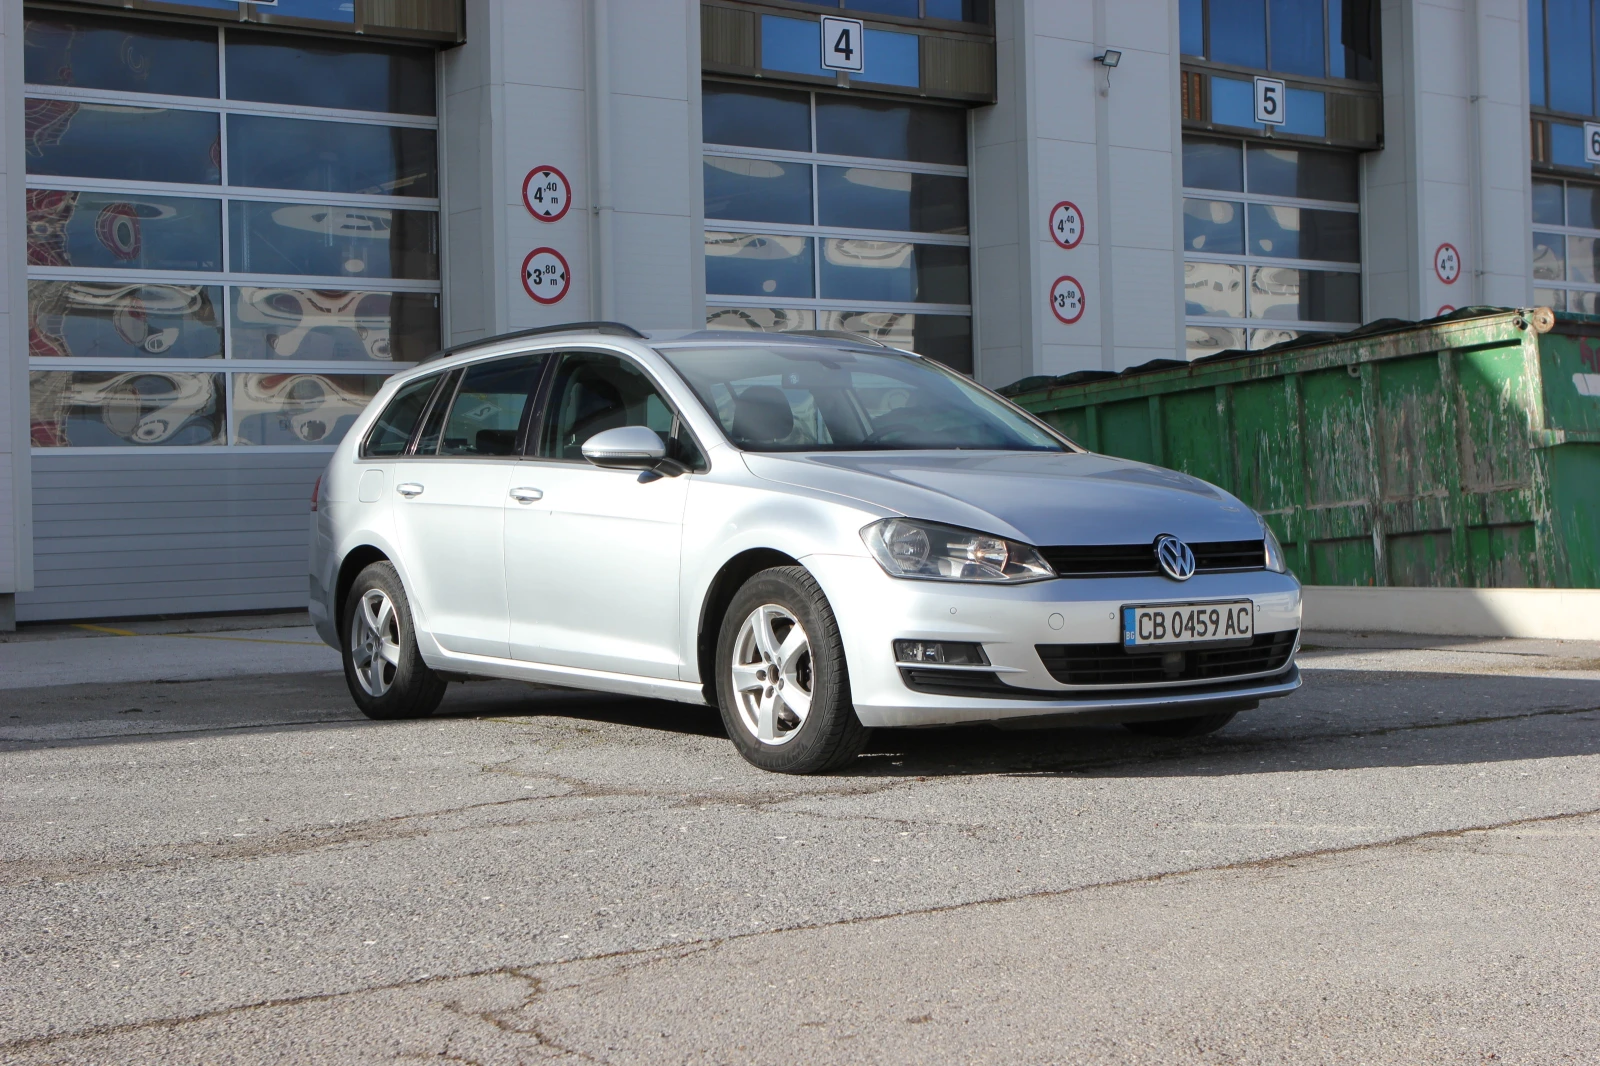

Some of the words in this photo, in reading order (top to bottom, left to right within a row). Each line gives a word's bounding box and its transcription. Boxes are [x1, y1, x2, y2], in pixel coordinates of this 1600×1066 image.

[834, 28, 853, 61] 4
[1263, 86, 1277, 115] 5
[1158, 536, 1195, 580] VW
[1126, 631, 1135, 640] BG
[1138, 612, 1166, 640] CB
[1171, 609, 1220, 638] 0459
[1225, 607, 1249, 635] AC
